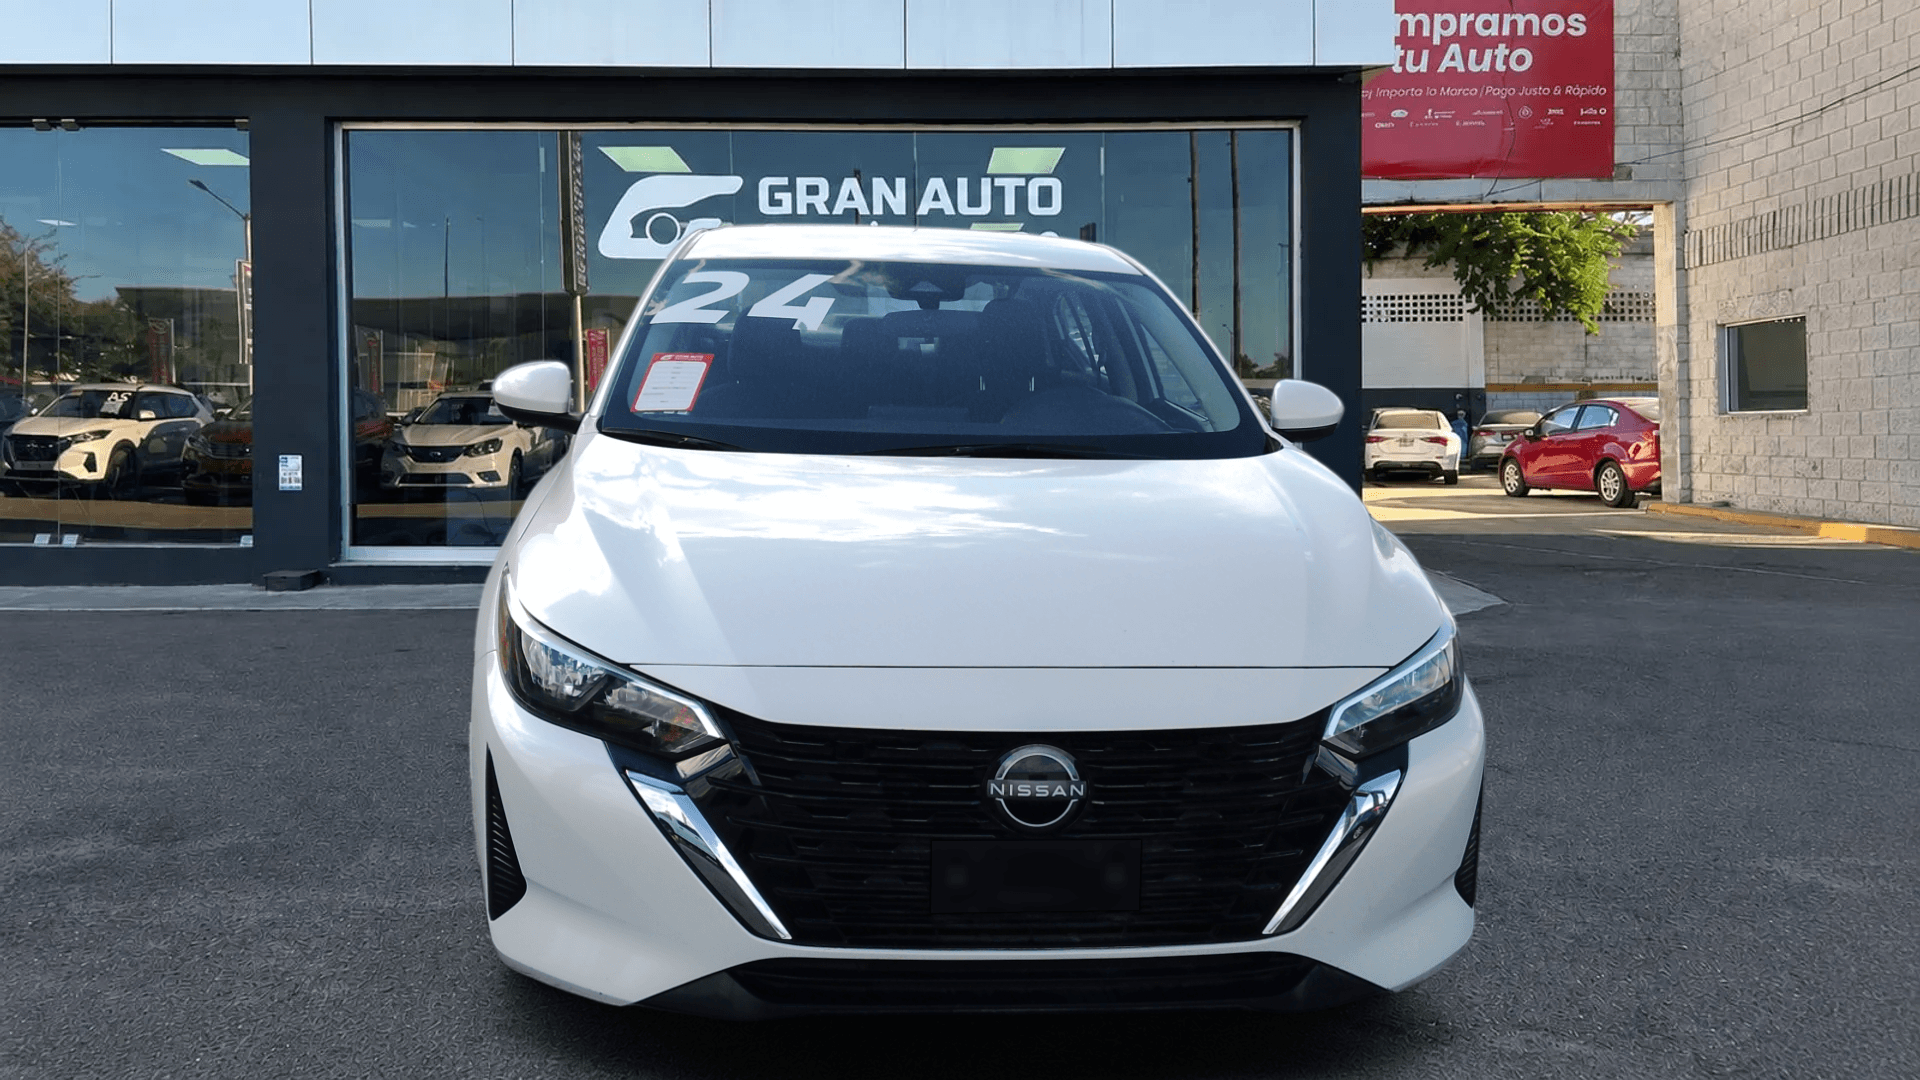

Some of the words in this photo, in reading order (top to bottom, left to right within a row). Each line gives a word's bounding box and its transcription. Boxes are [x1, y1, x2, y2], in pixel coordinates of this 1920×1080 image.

[1394, 13, 1587, 46] mpramos
[1392, 44, 1430, 73] tu
[1437, 43, 1533, 73] Auto
[1375, 87, 1424, 100] Importa
[1426, 86, 1438, 97] la
[1439, 86, 1479, 97] Marca
[1518, 86, 1551, 96] Justo
[1552, 85, 1562, 96] &
[1564, 83, 1608, 98] Rápido
[758, 177, 907, 215] GRAN
[916, 177, 1063, 216] AUTO
[650, 270, 836, 331] 24
[990, 782, 1085, 797] NISSAN
